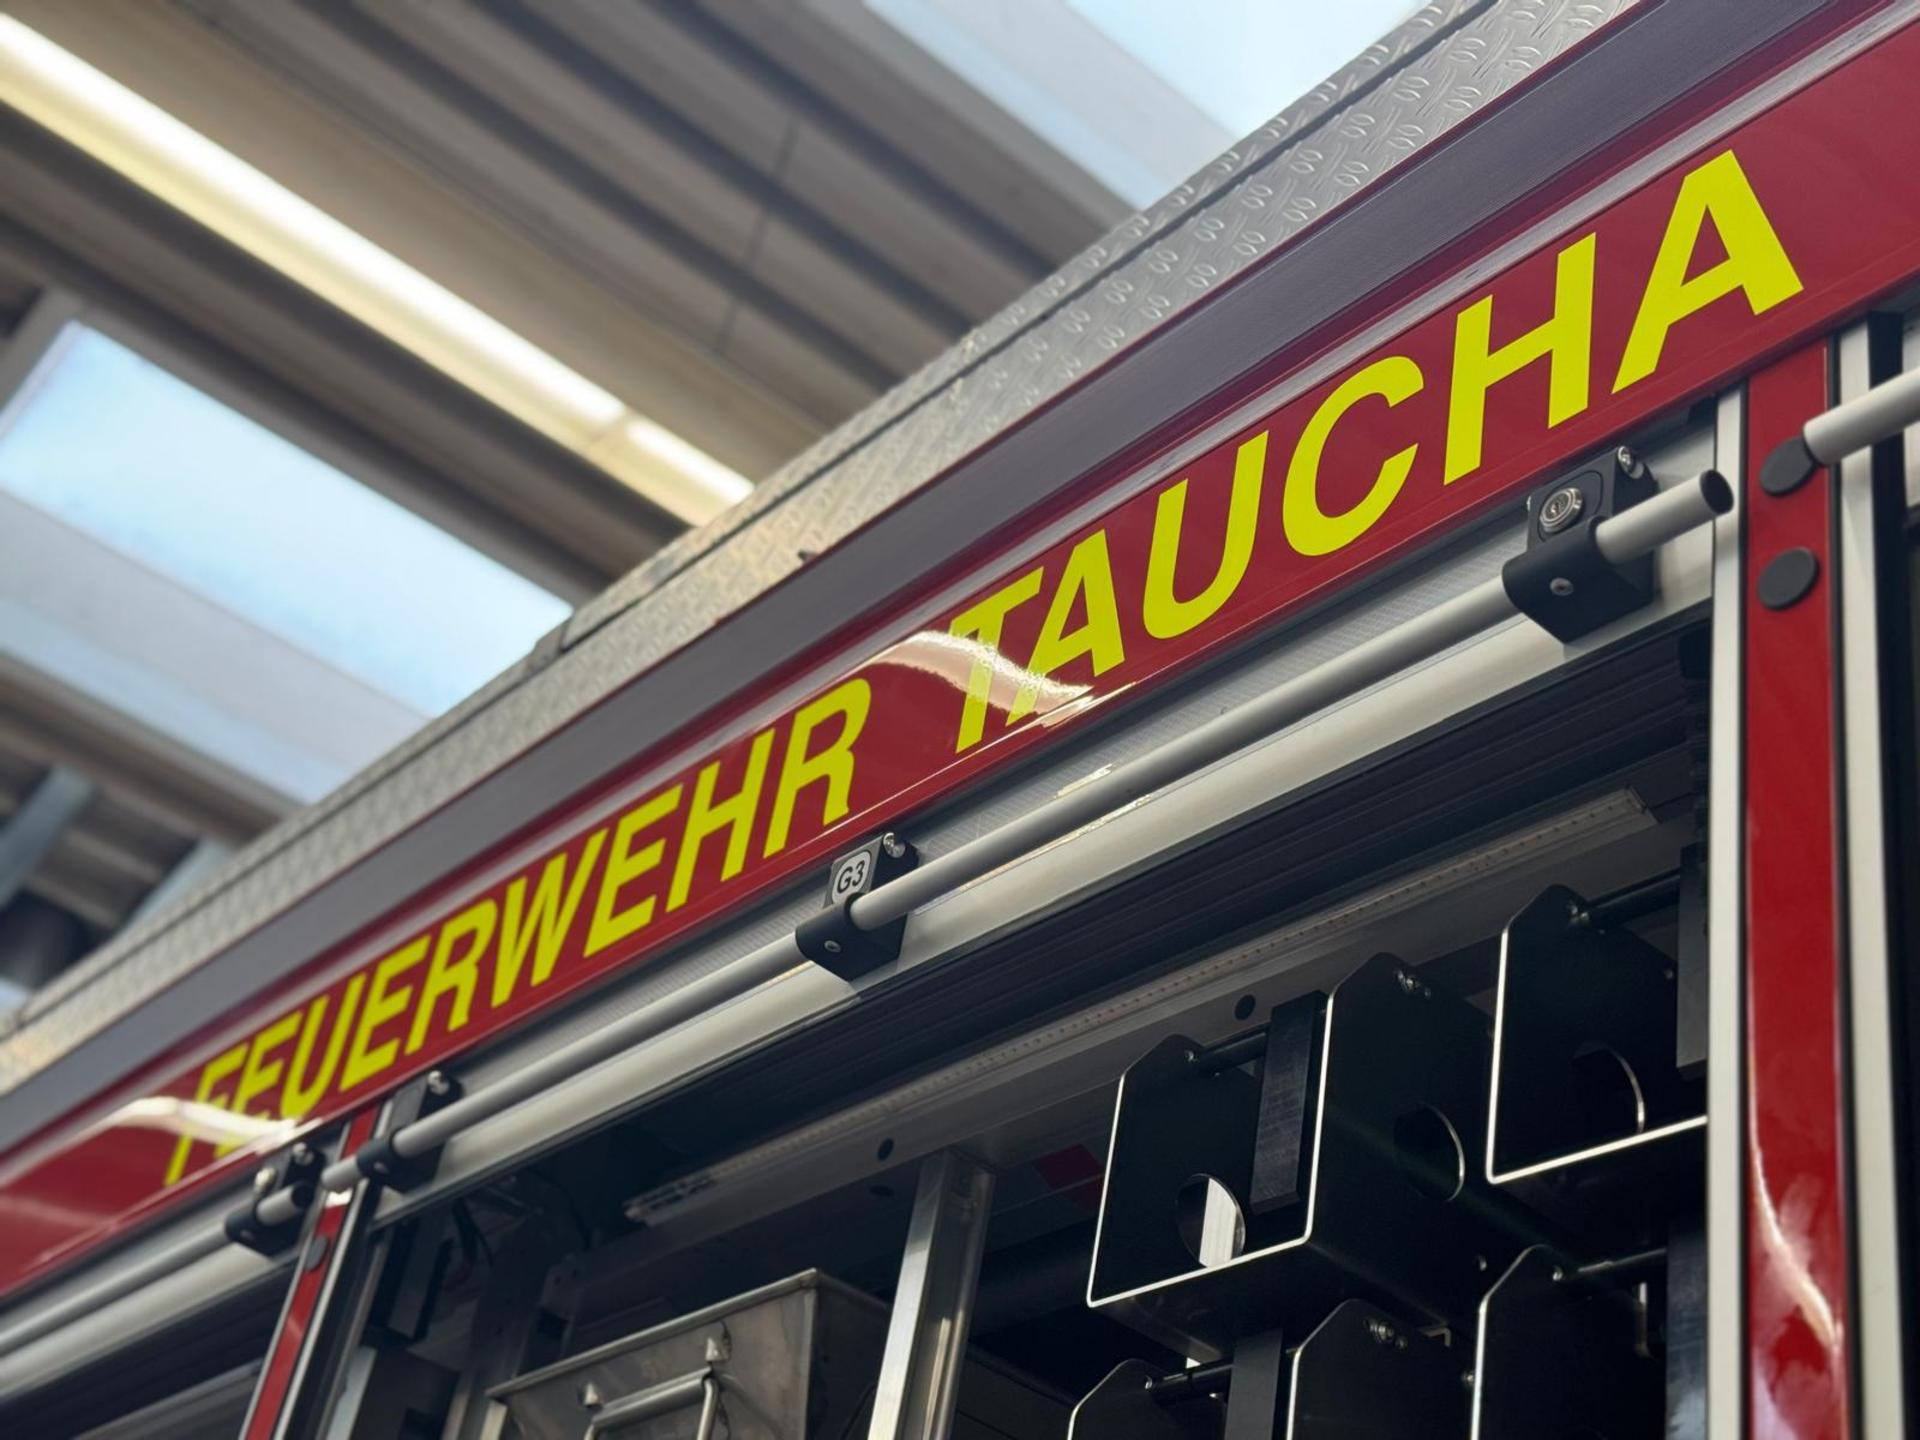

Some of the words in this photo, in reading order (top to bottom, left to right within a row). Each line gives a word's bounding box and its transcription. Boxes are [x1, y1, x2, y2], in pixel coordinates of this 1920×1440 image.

[164, 680, 871, 1187] FEUERWEHR
[948, 149, 1803, 753] TAUCHA
[837, 860, 866, 893] G3
